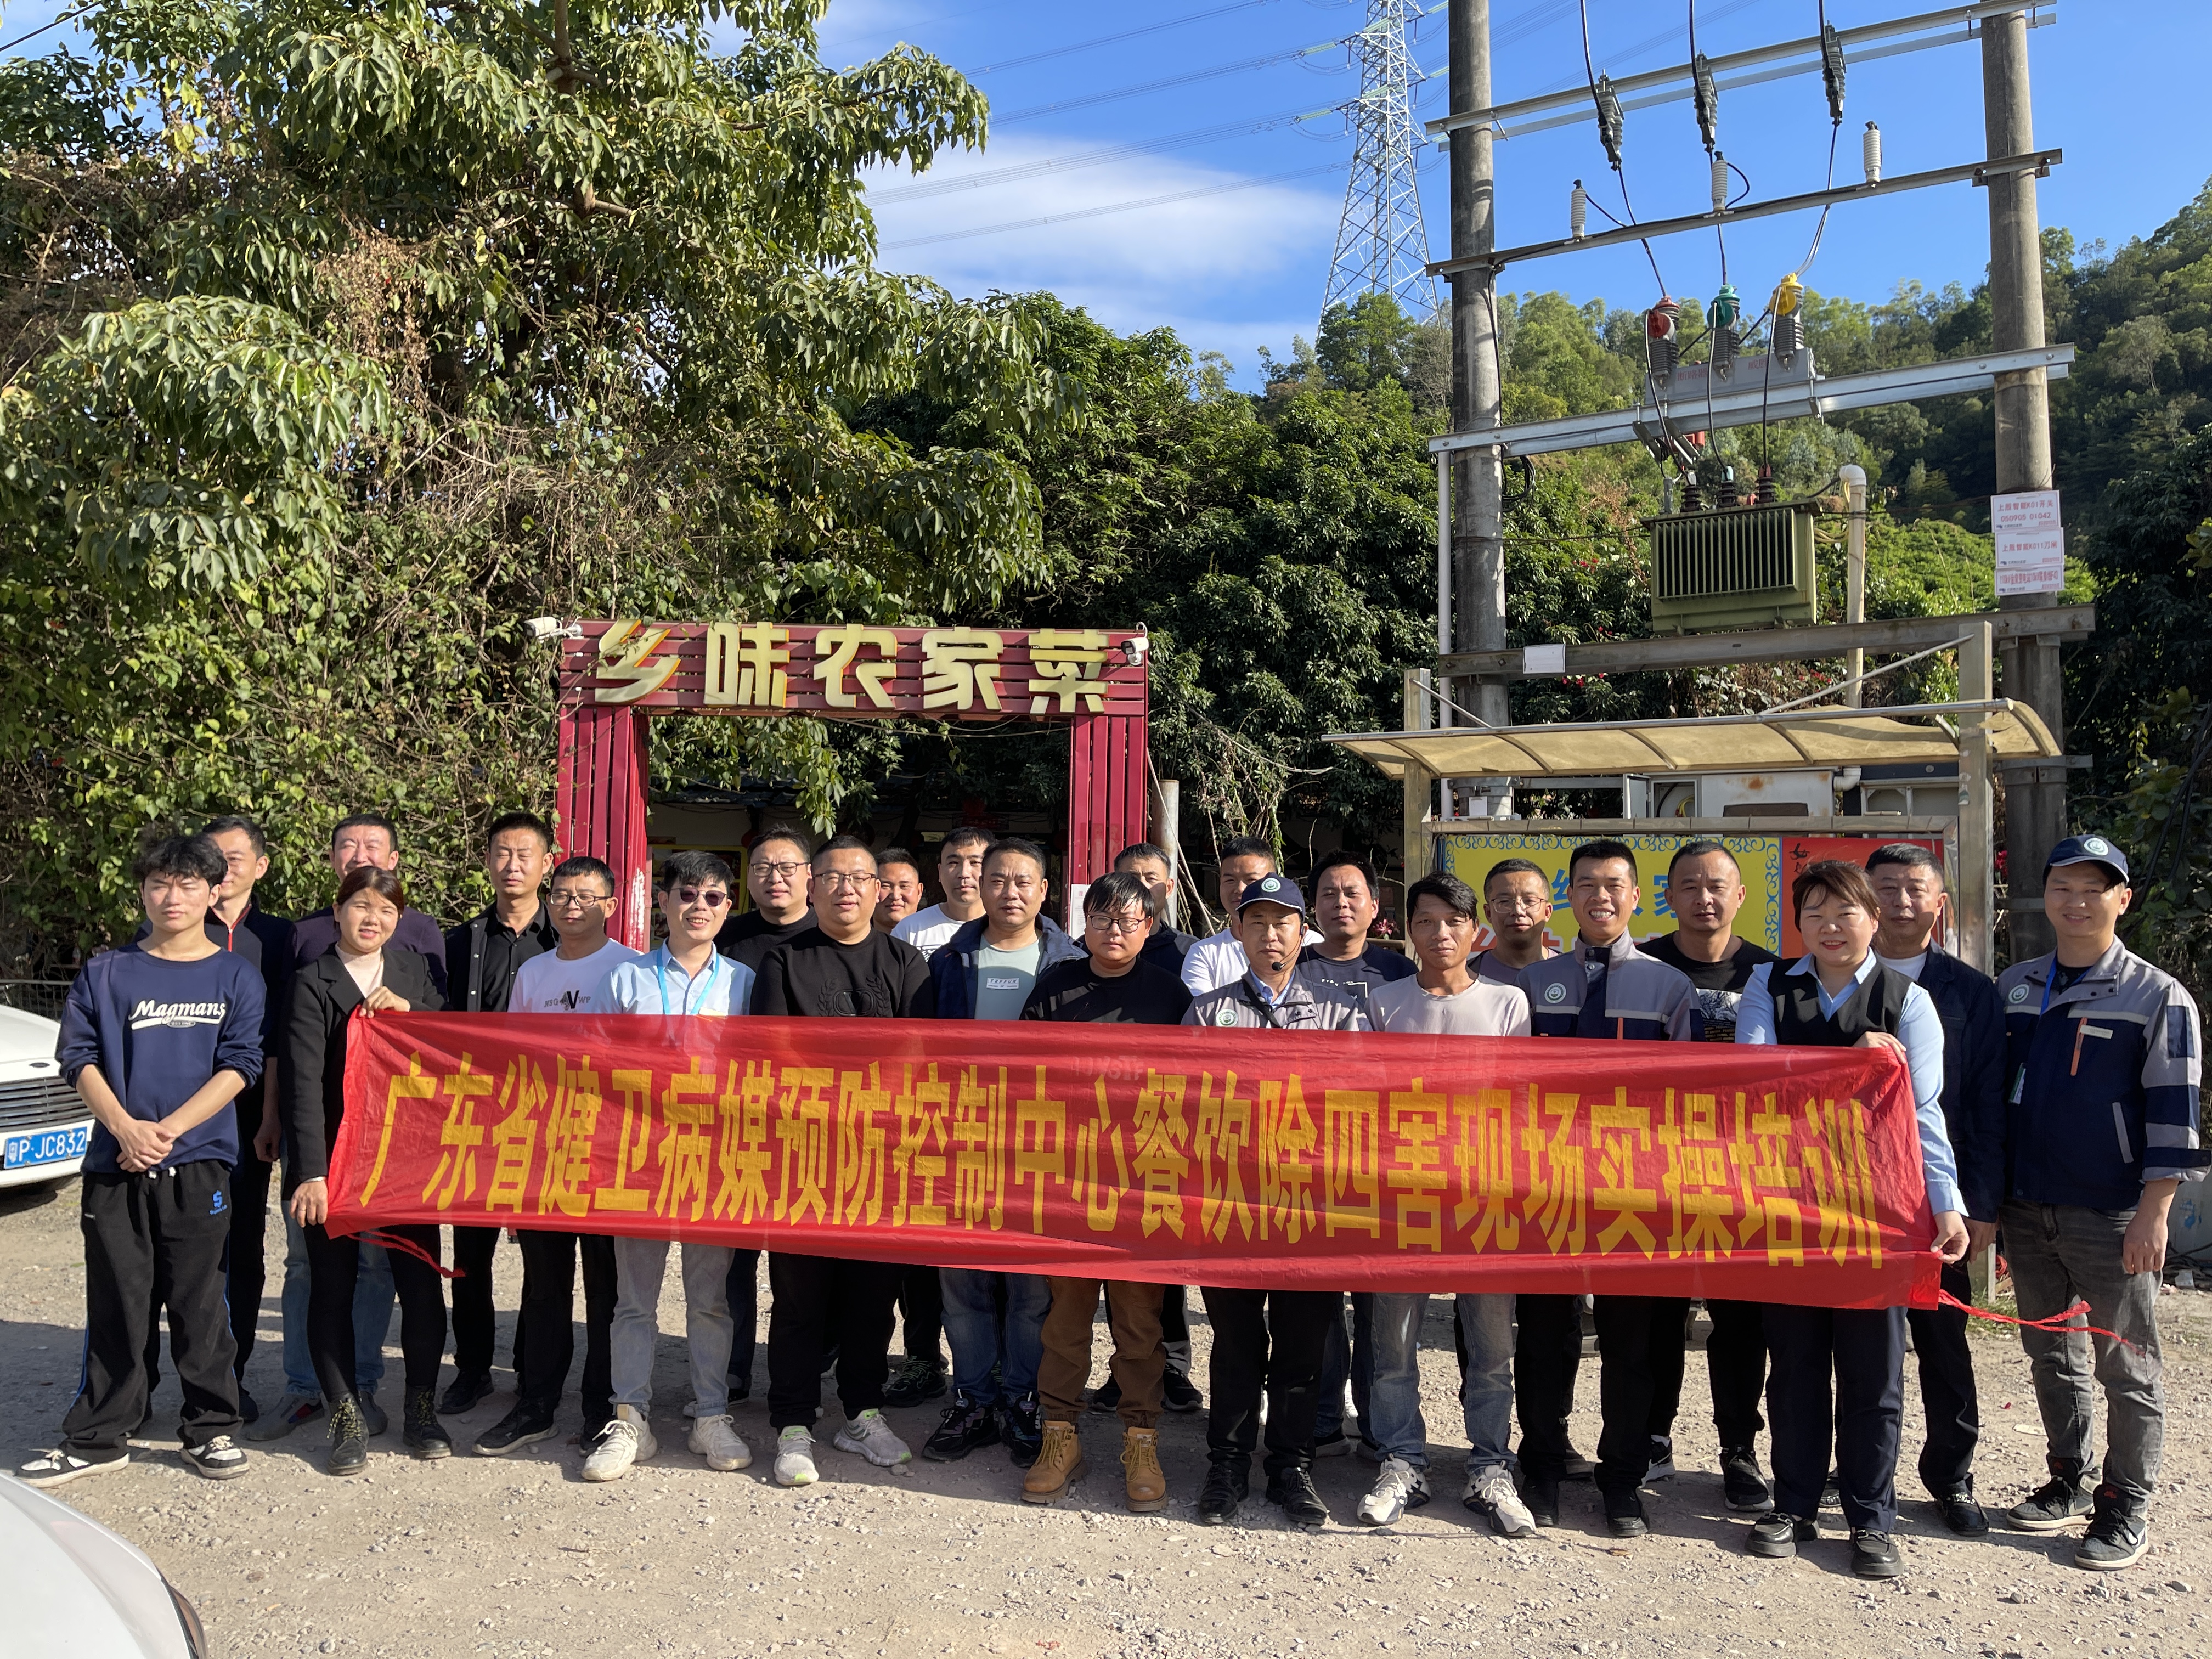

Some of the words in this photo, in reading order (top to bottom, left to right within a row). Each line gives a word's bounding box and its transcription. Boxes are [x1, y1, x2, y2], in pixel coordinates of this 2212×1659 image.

[594, 619, 1109, 714] 乡味农家菜
[128, 1000, 225, 1024] Magmans
[359, 1050, 1882, 1269] 广东省健卫病媒预防控制中心餐饮除四害现场实操培训
